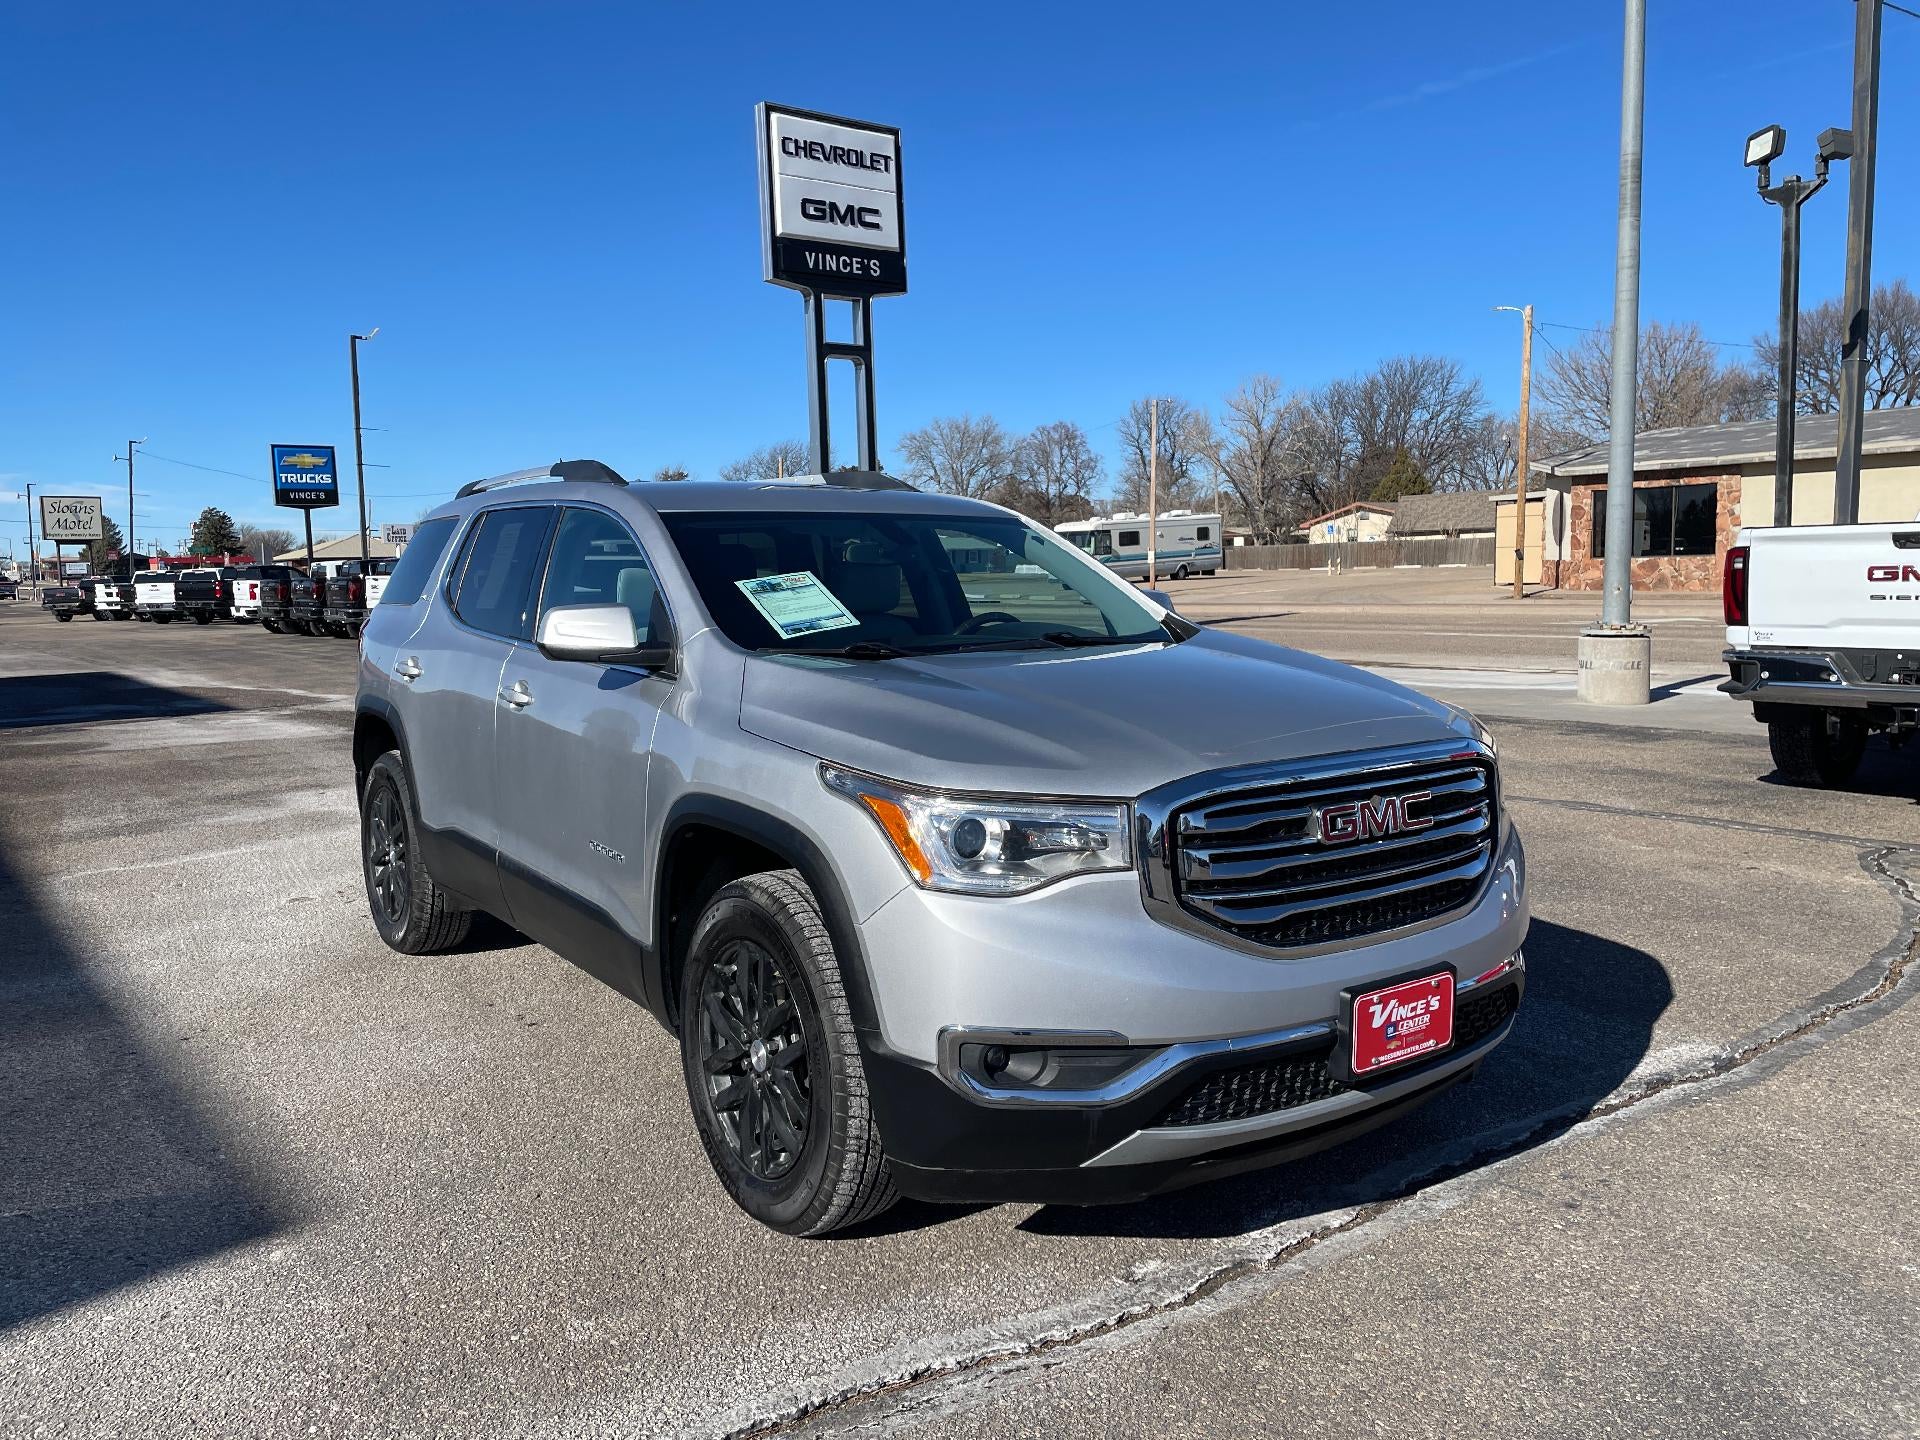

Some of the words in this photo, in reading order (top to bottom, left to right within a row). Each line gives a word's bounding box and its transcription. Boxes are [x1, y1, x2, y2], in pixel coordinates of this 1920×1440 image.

[781, 136, 894, 174] CHEVROLET
[800, 198, 882, 231] GMC
[805, 251, 881, 277] VINCE'S
[279, 473, 332, 484] TRUCKS
[289, 491, 326, 500] VINCE'S
[48, 499, 95, 514] Sloans
[51, 516, 94, 530] Motel
[1320, 790, 1434, 845] GMC
[1398, 1014, 1431, 1032] CENTER
